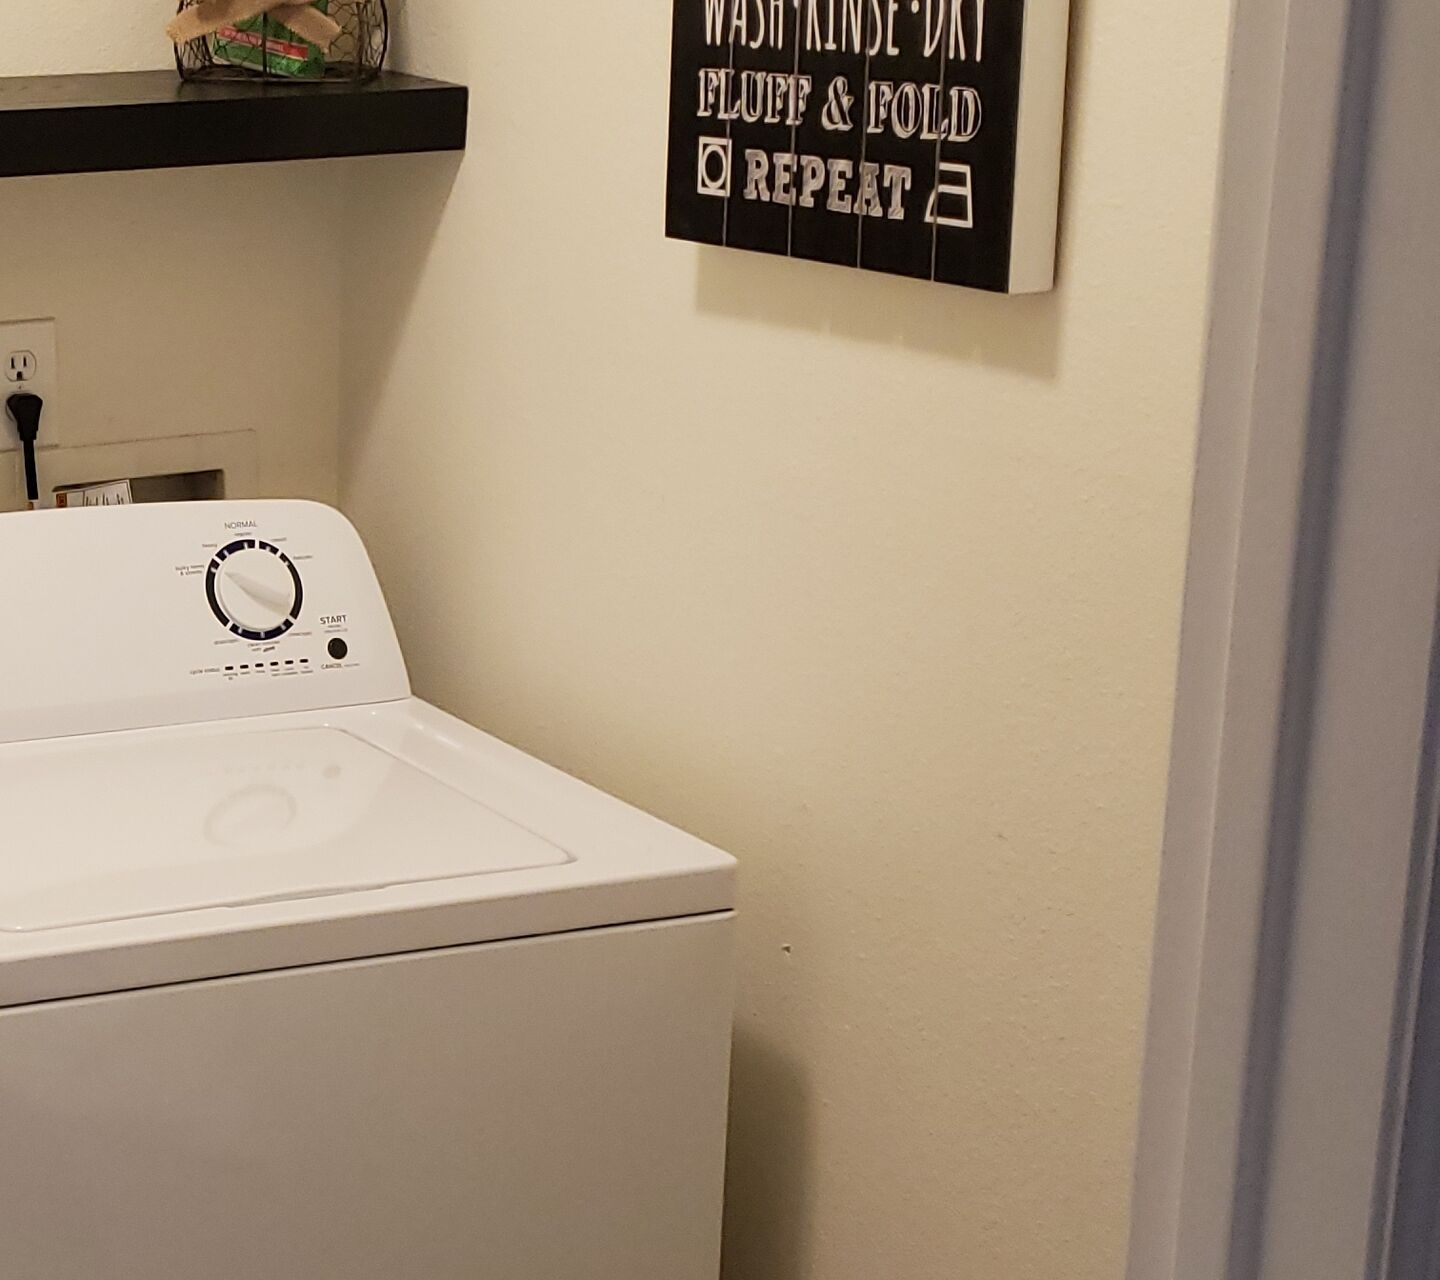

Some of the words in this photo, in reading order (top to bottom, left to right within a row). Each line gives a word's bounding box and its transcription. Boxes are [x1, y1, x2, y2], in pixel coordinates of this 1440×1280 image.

[696, 68, 812, 126] FLUFF
[822, 76, 855, 131] &
[866, 81, 983, 142] FOLD
[743, 149, 912, 220] REPEAT
[224, 520, 258, 530] NORMAL
[320, 614, 348, 625] START
